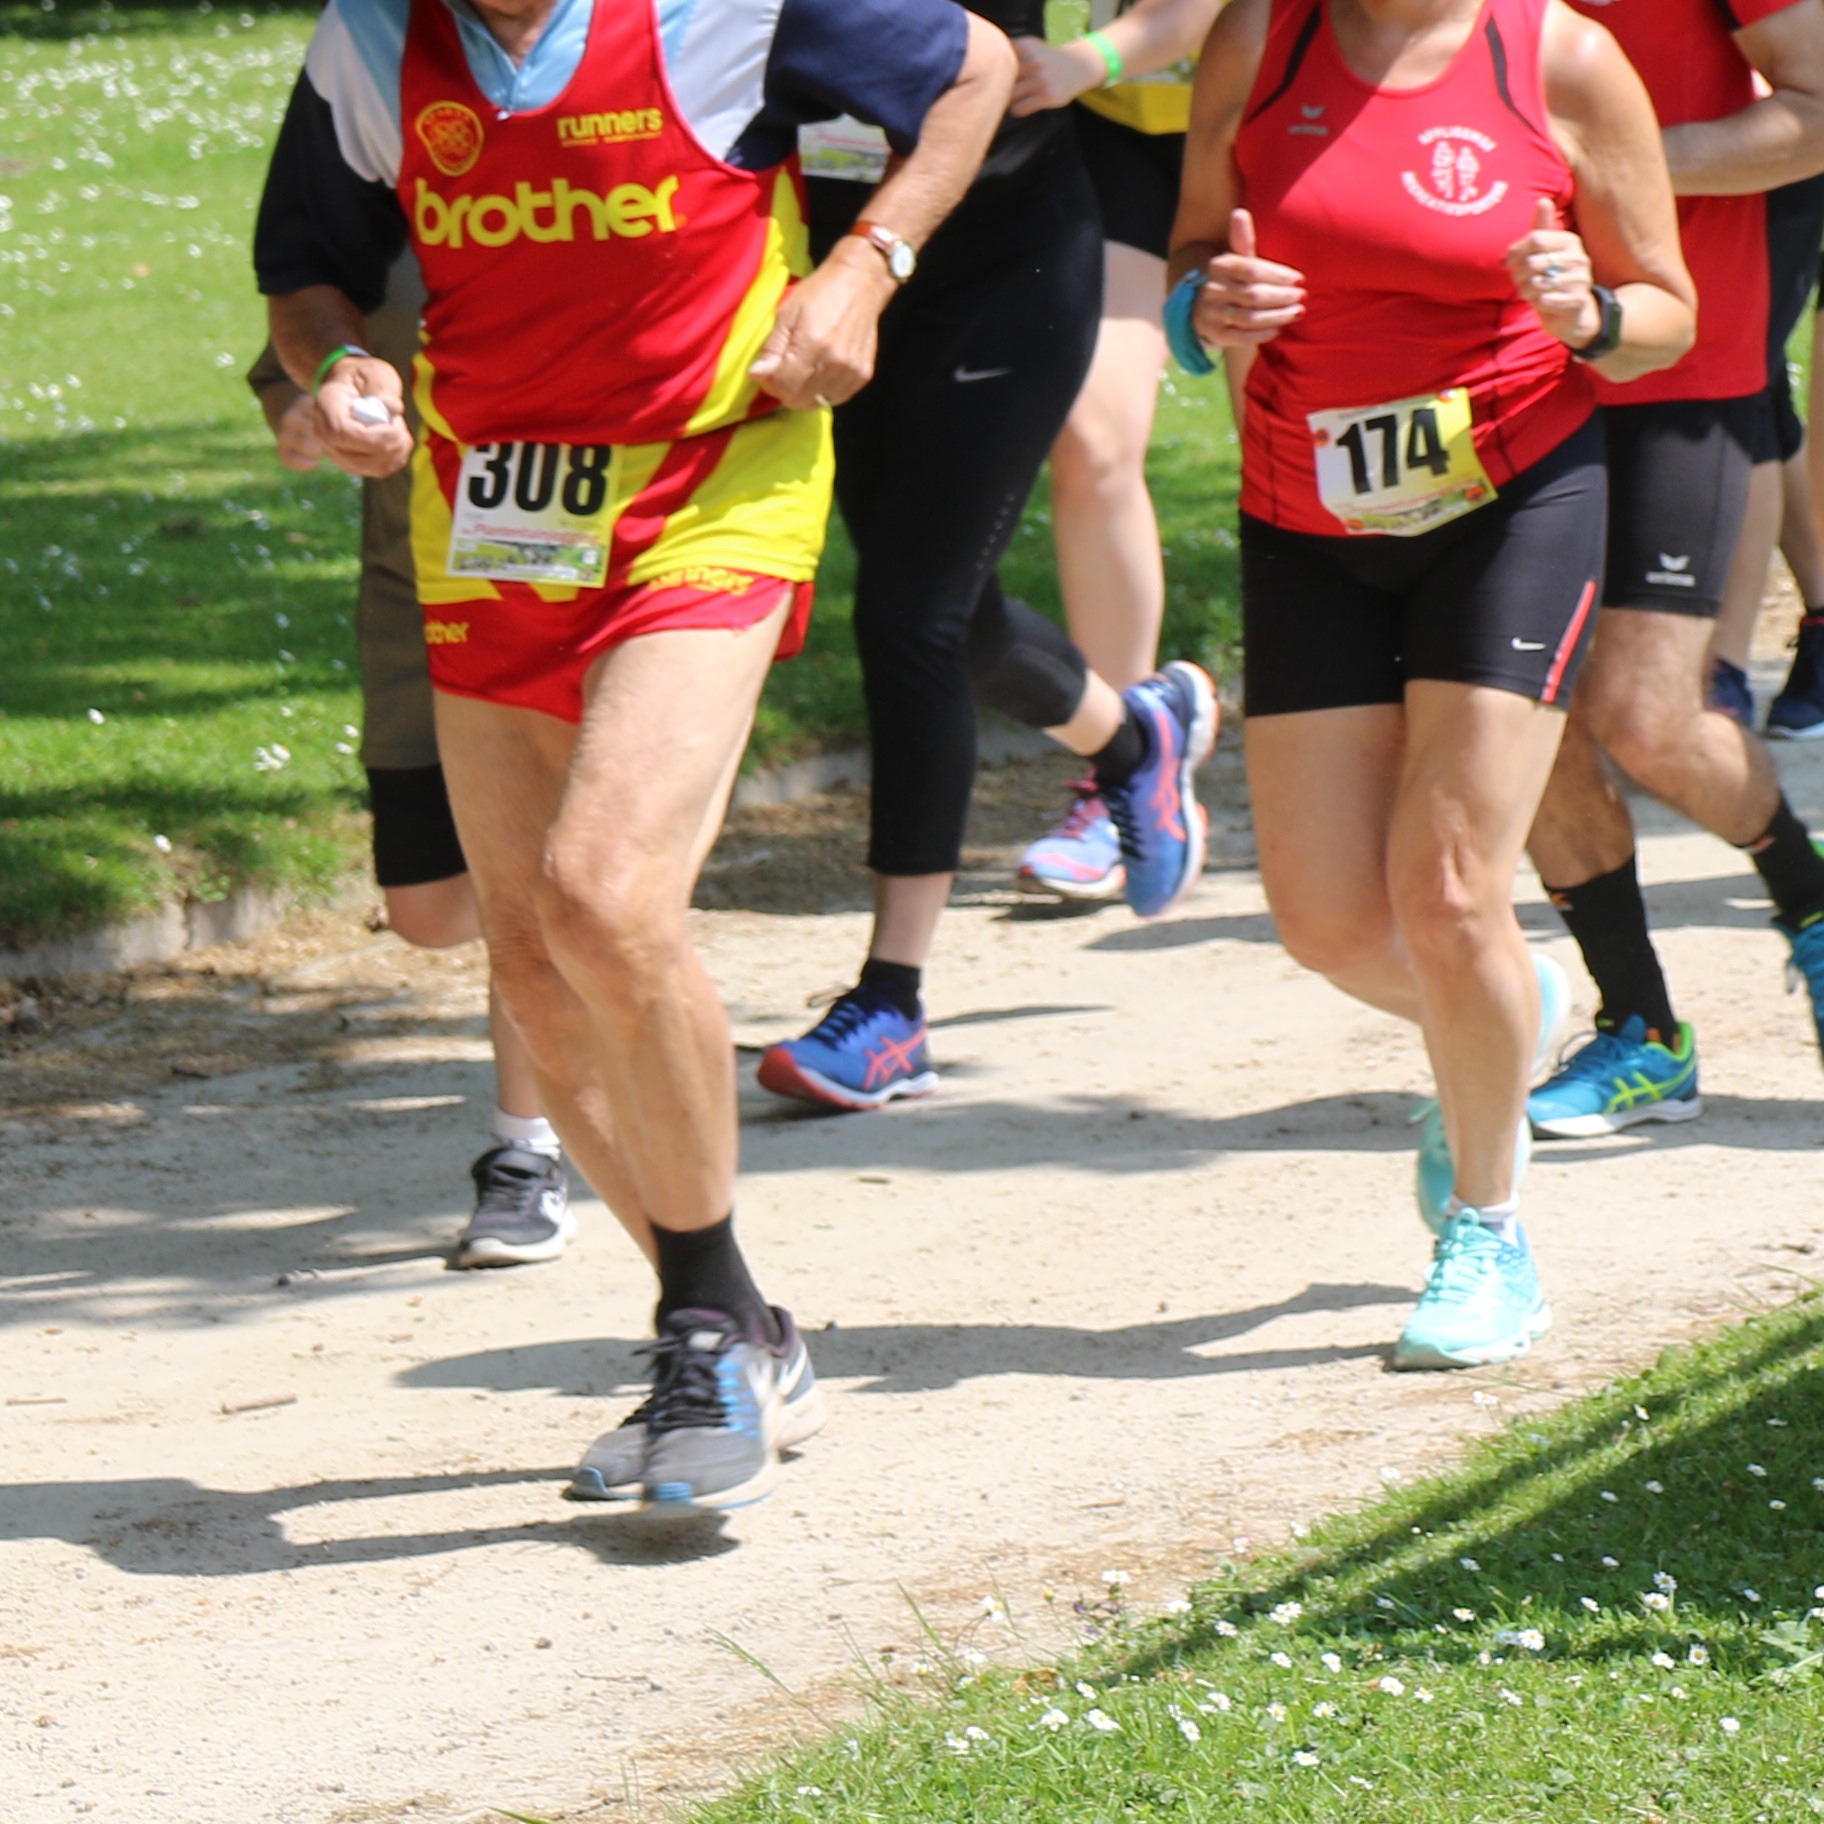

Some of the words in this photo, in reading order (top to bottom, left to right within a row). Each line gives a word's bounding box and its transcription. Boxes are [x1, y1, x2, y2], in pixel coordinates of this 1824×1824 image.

[556, 107, 664, 140] runners
[414, 174, 680, 249] brother
[467, 441, 614, 516] 308
[1336, 407, 1450, 496] 174
